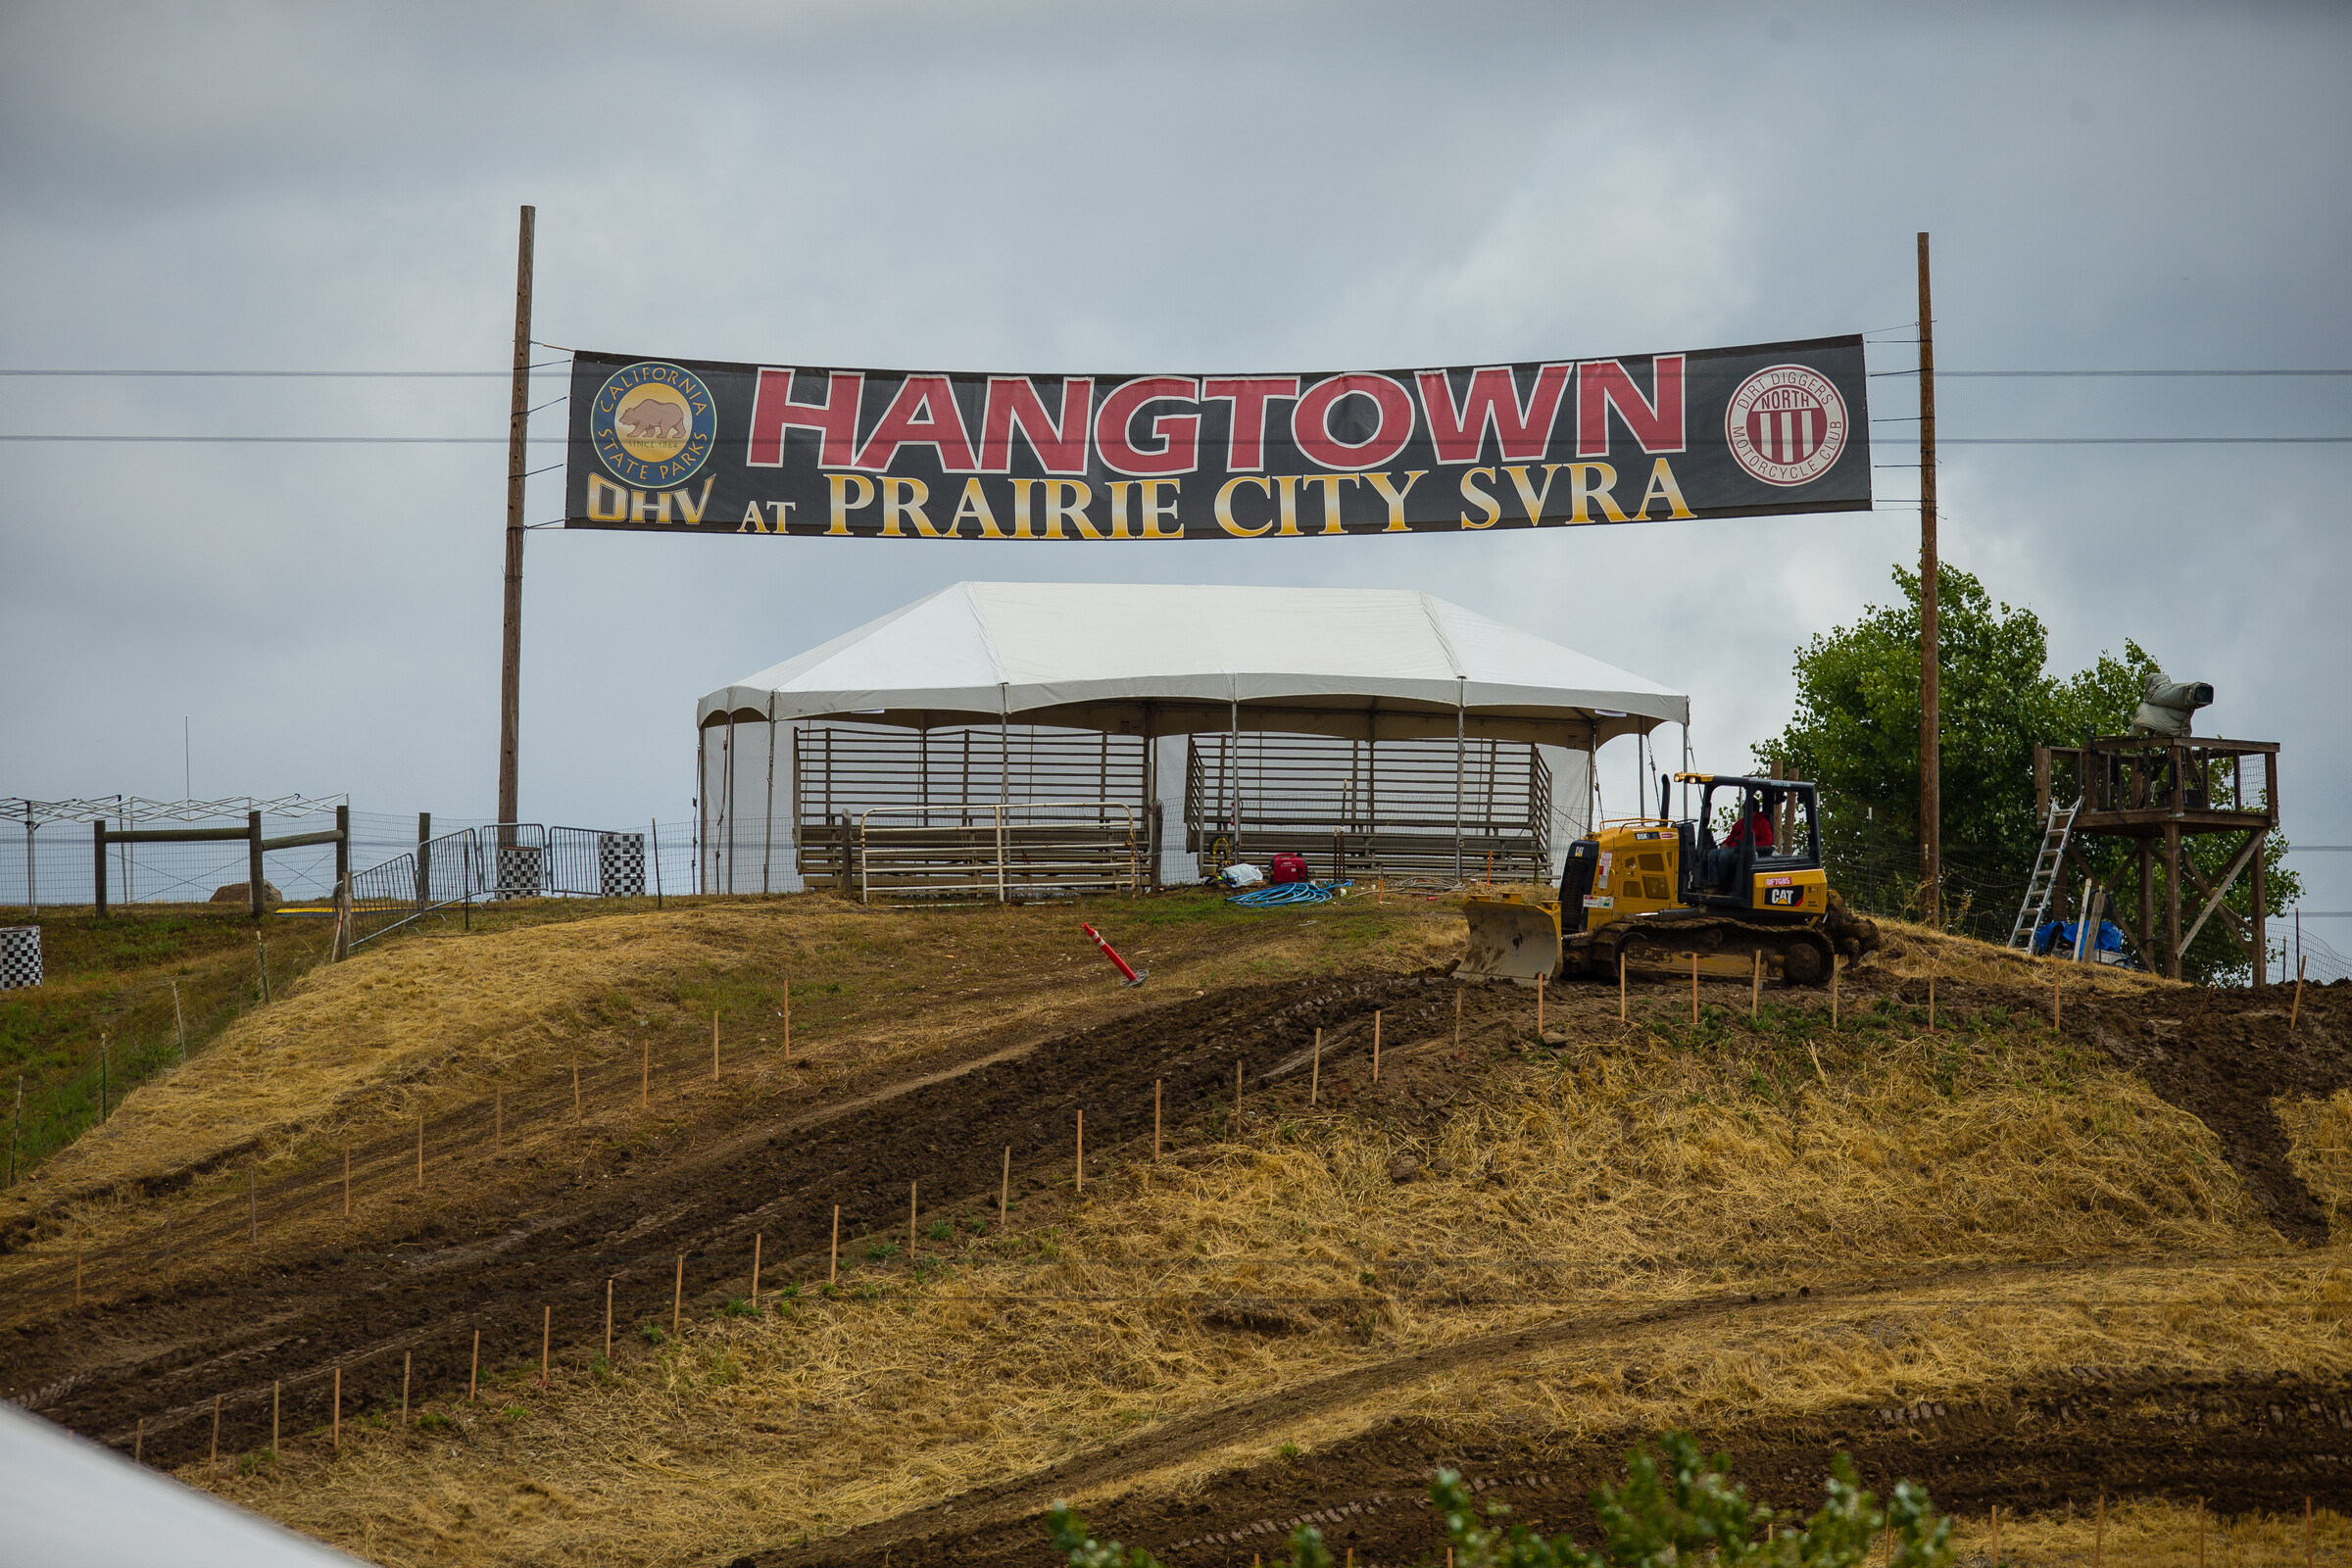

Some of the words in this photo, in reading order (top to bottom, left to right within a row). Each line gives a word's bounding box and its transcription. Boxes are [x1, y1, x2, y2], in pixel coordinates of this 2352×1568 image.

[601, 367, 708, 416] CALIFORNIA
[747, 353, 1687, 476] HANGTOWN
[1737, 378, 1767, 410] DIRT
[1771, 371, 1834, 406] DIGGERS
[1761, 389, 1810, 410] NORTH
[598, 428, 649, 480] STATE
[660, 431, 708, 479] PARKS
[628, 440, 655, 449] SINCE
[1732, 425, 1819, 479] MOTORCYCLE
[1819, 420, 1842, 461] CLUB
[587, 471, 717, 525] OHV
[736, 500, 796, 534] AT
[823, 473, 1185, 540] PRAIRIE
[1213, 469, 1429, 538] CITY
[1459, 457, 1698, 529] SVRA
[1771, 888, 1793, 905] CAT
